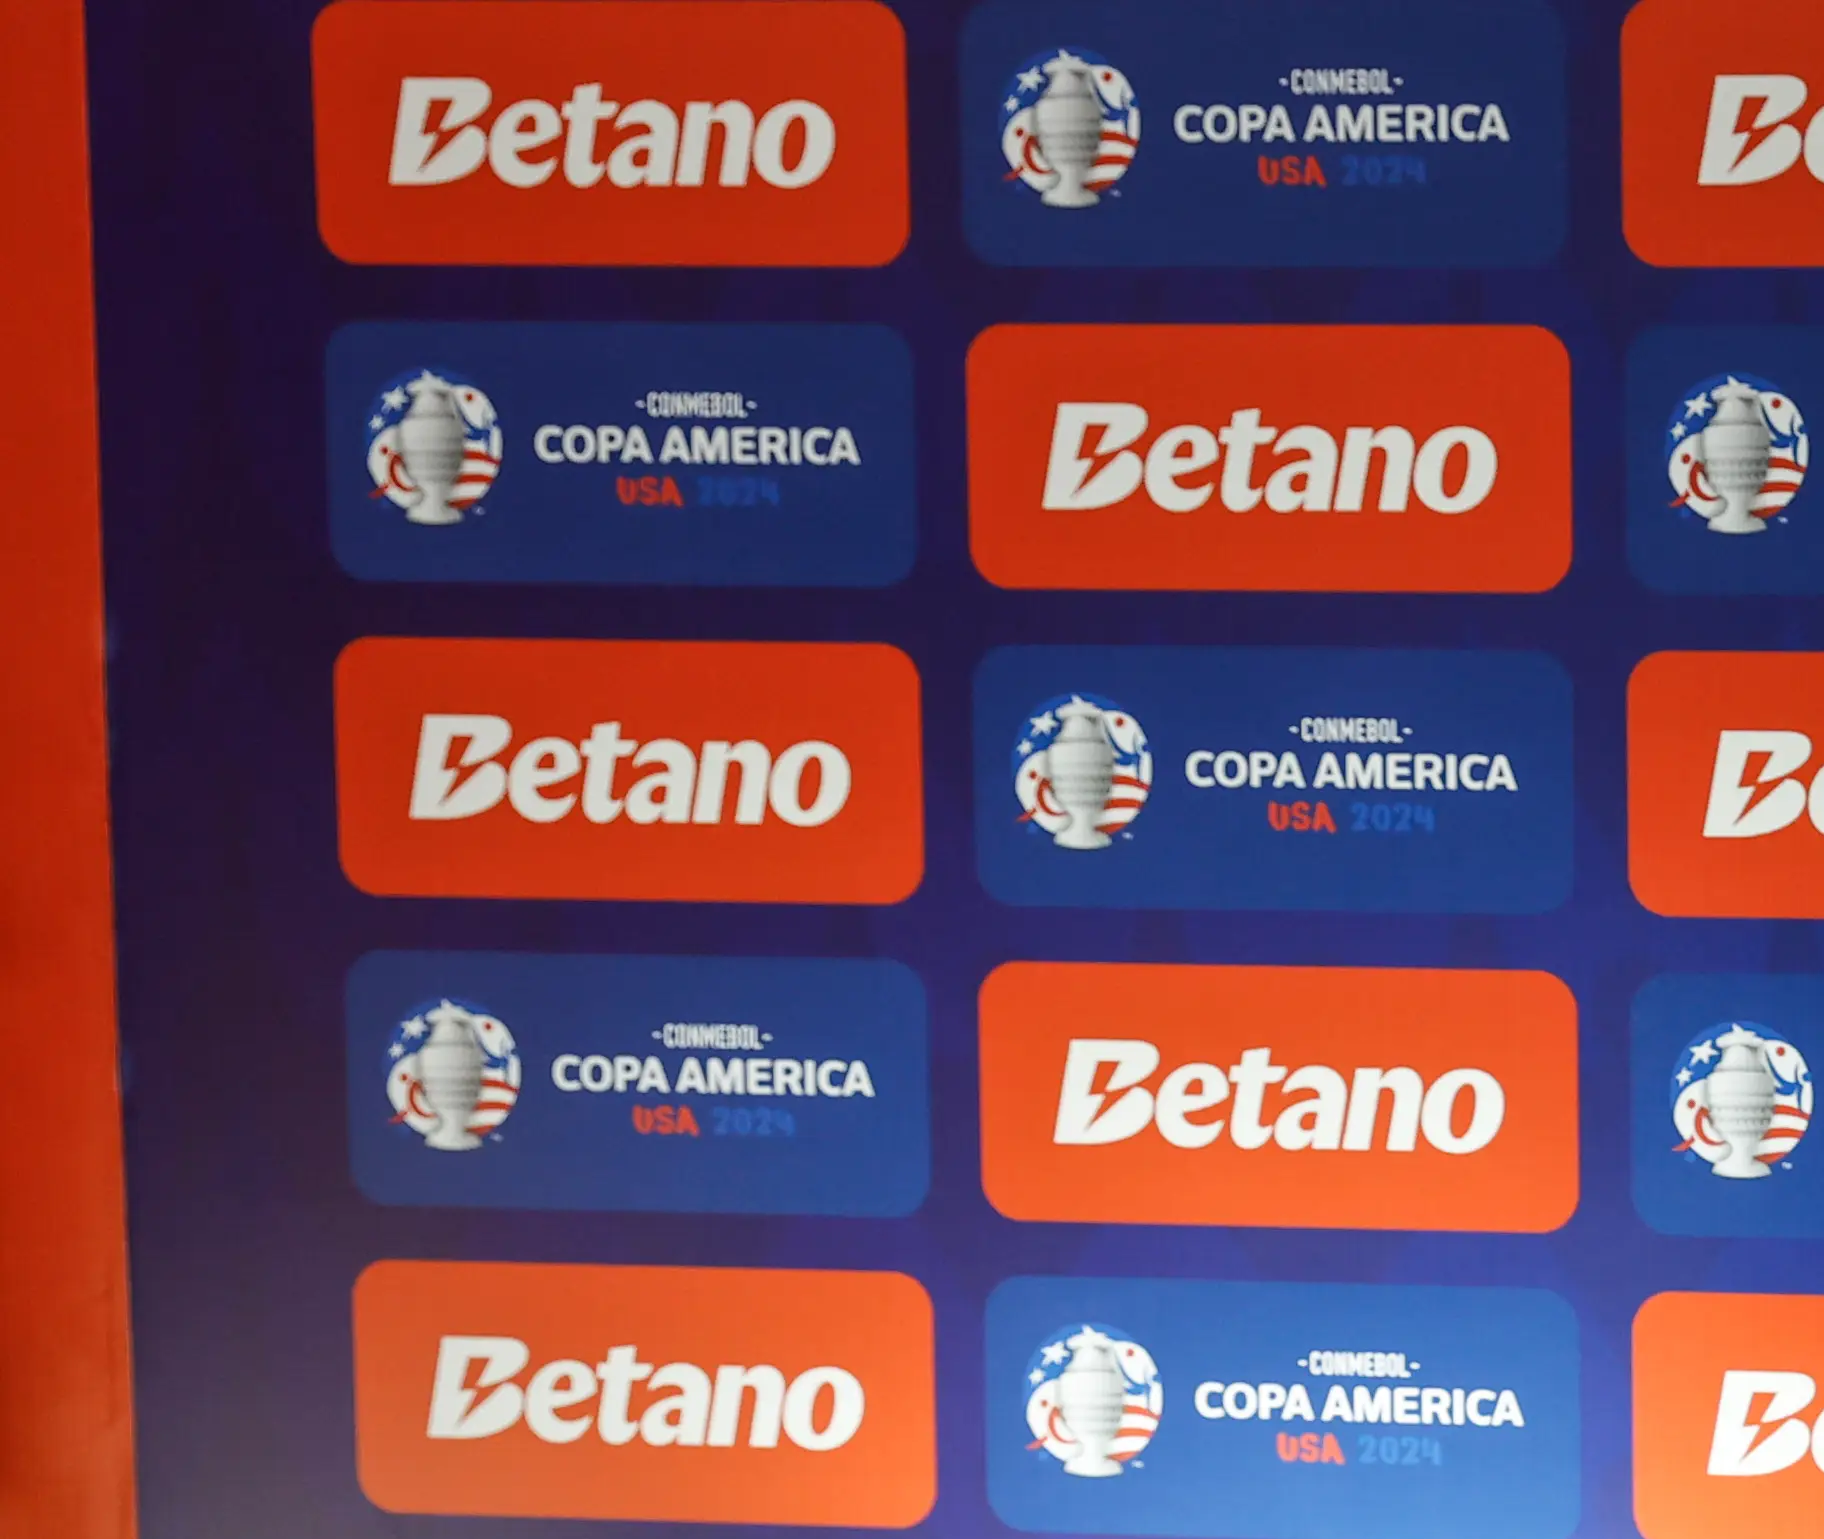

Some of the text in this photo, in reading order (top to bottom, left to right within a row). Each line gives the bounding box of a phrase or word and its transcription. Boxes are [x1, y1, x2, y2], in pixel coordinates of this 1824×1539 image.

[390, 78, 835, 188] Betano
[1175, 104, 1509, 142] COPA AMERICA
[1259, 156, 1325, 185] USA
[535, 425, 860, 464] COPA AMERICA
[1043, 403, 1496, 513] Betano
[618, 477, 682, 506] USA
[410, 715, 850, 826] Betano
[1186, 751, 1517, 790] COPA AMERICA
[1269, 802, 1336, 831] USA
[553, 1055, 874, 1097] COPA AMERICA
[1054, 1040, 1504, 1153] Betano
[634, 1106, 698, 1134] USA
[428, 1337, 864, 1450] Betano
[1195, 1382, 1524, 1427] COPA AMERICA
[1278, 1434, 1343, 1463] USA
